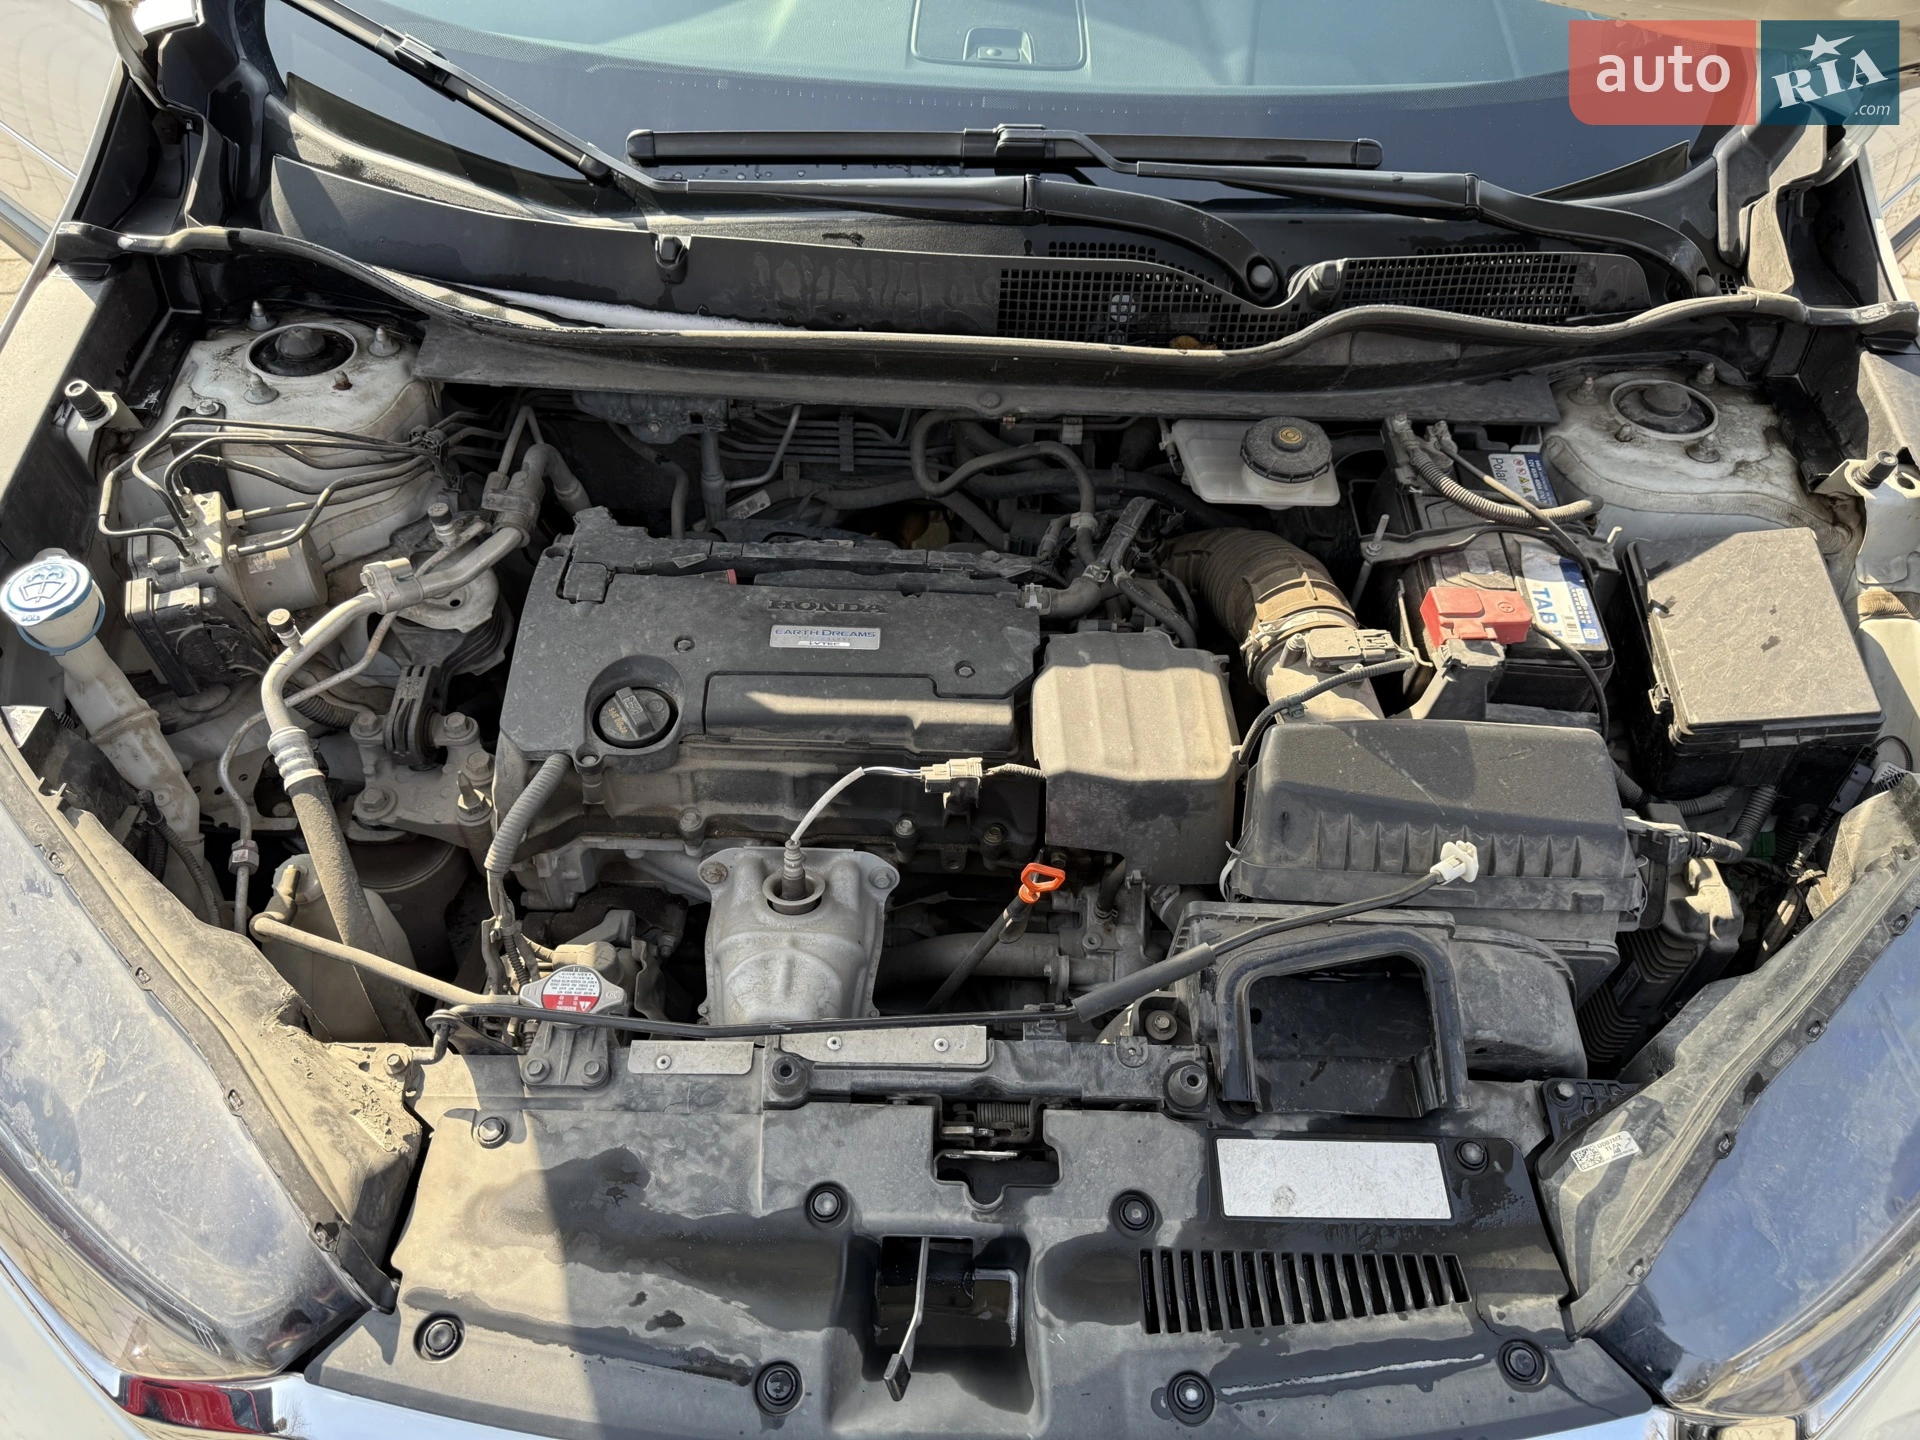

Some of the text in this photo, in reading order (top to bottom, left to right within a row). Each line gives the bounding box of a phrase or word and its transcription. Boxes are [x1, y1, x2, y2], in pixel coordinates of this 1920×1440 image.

[1491, 457, 1508, 483] Polar
[768, 600, 887, 614] HONDA
[1532, 587, 1558, 624] TAB
[775, 628, 819, 636] EARTH
